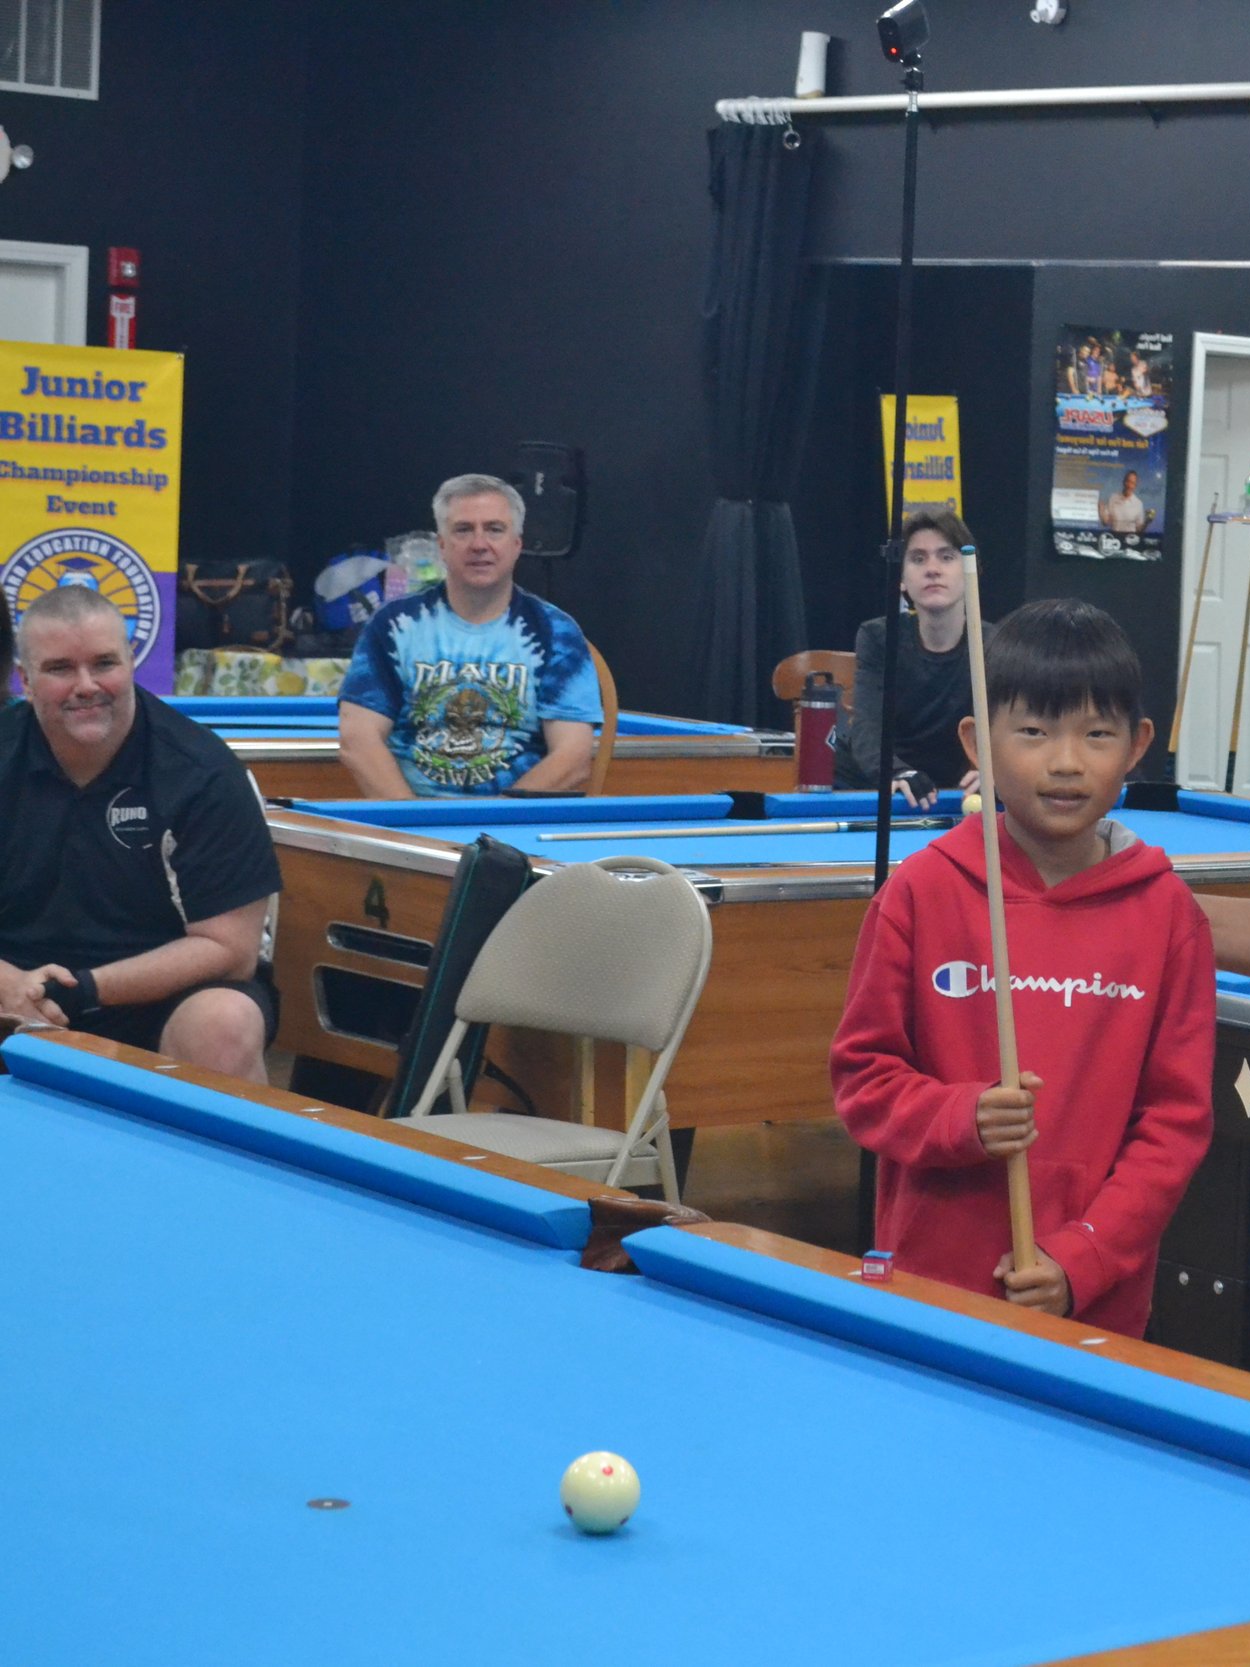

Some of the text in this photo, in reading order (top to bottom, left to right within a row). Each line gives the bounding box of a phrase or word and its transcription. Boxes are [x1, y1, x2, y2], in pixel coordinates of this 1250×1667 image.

[20, 366, 147, 402] Junior
[0, 411, 168, 450] Billiards
[0, 460, 169, 492] Championship
[46, 495, 118, 517] Event
[22, 536, 112, 568] EDUCATION
[111, 549, 154, 641] FOUNDATION
[932, 960, 1146, 1008] Champion
